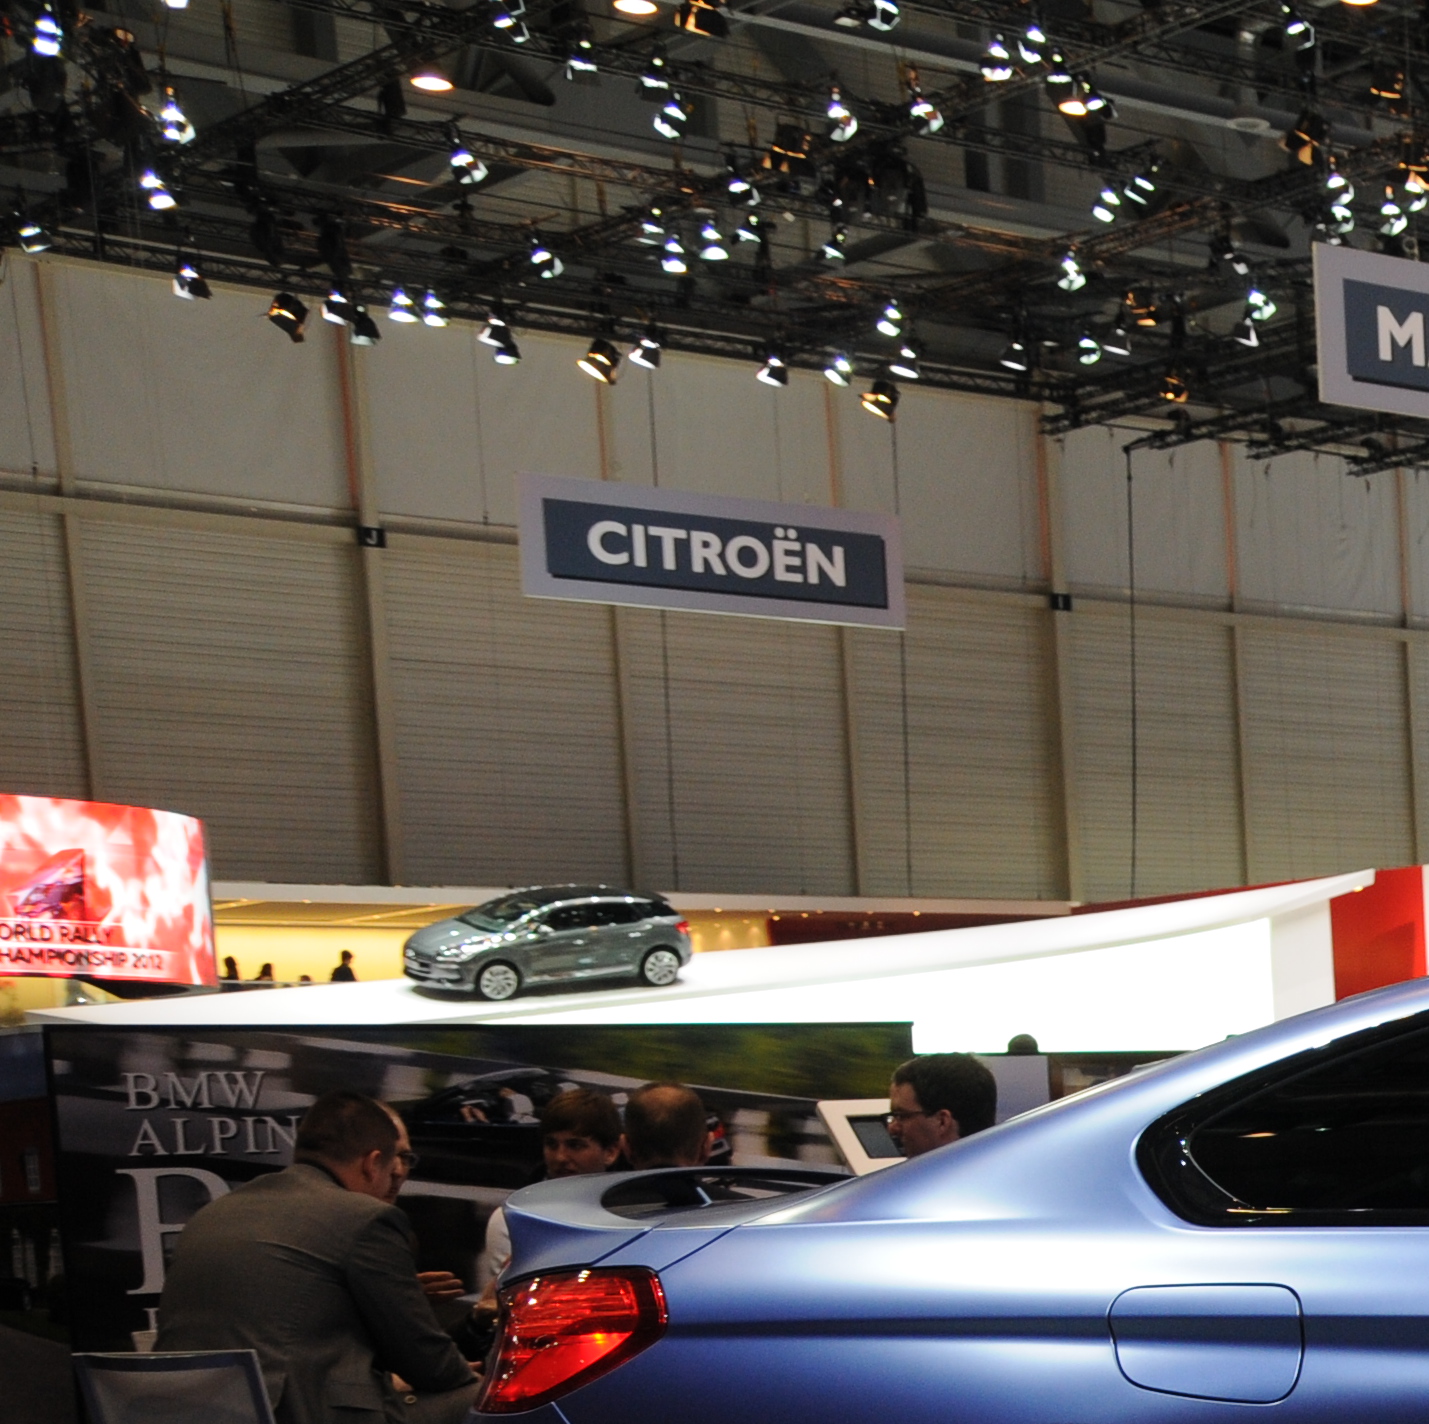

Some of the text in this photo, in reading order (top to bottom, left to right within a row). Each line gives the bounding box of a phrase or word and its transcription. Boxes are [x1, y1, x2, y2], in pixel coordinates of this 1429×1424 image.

[587, 520, 847, 587] CITROËN
[0, 923, 112, 944] ORLD RALLY
[0, 949, 163, 970] HAMPIONSHIP 2012
[121, 1070, 266, 1111] BMW
[127, 1115, 301, 1157] ALPIN
